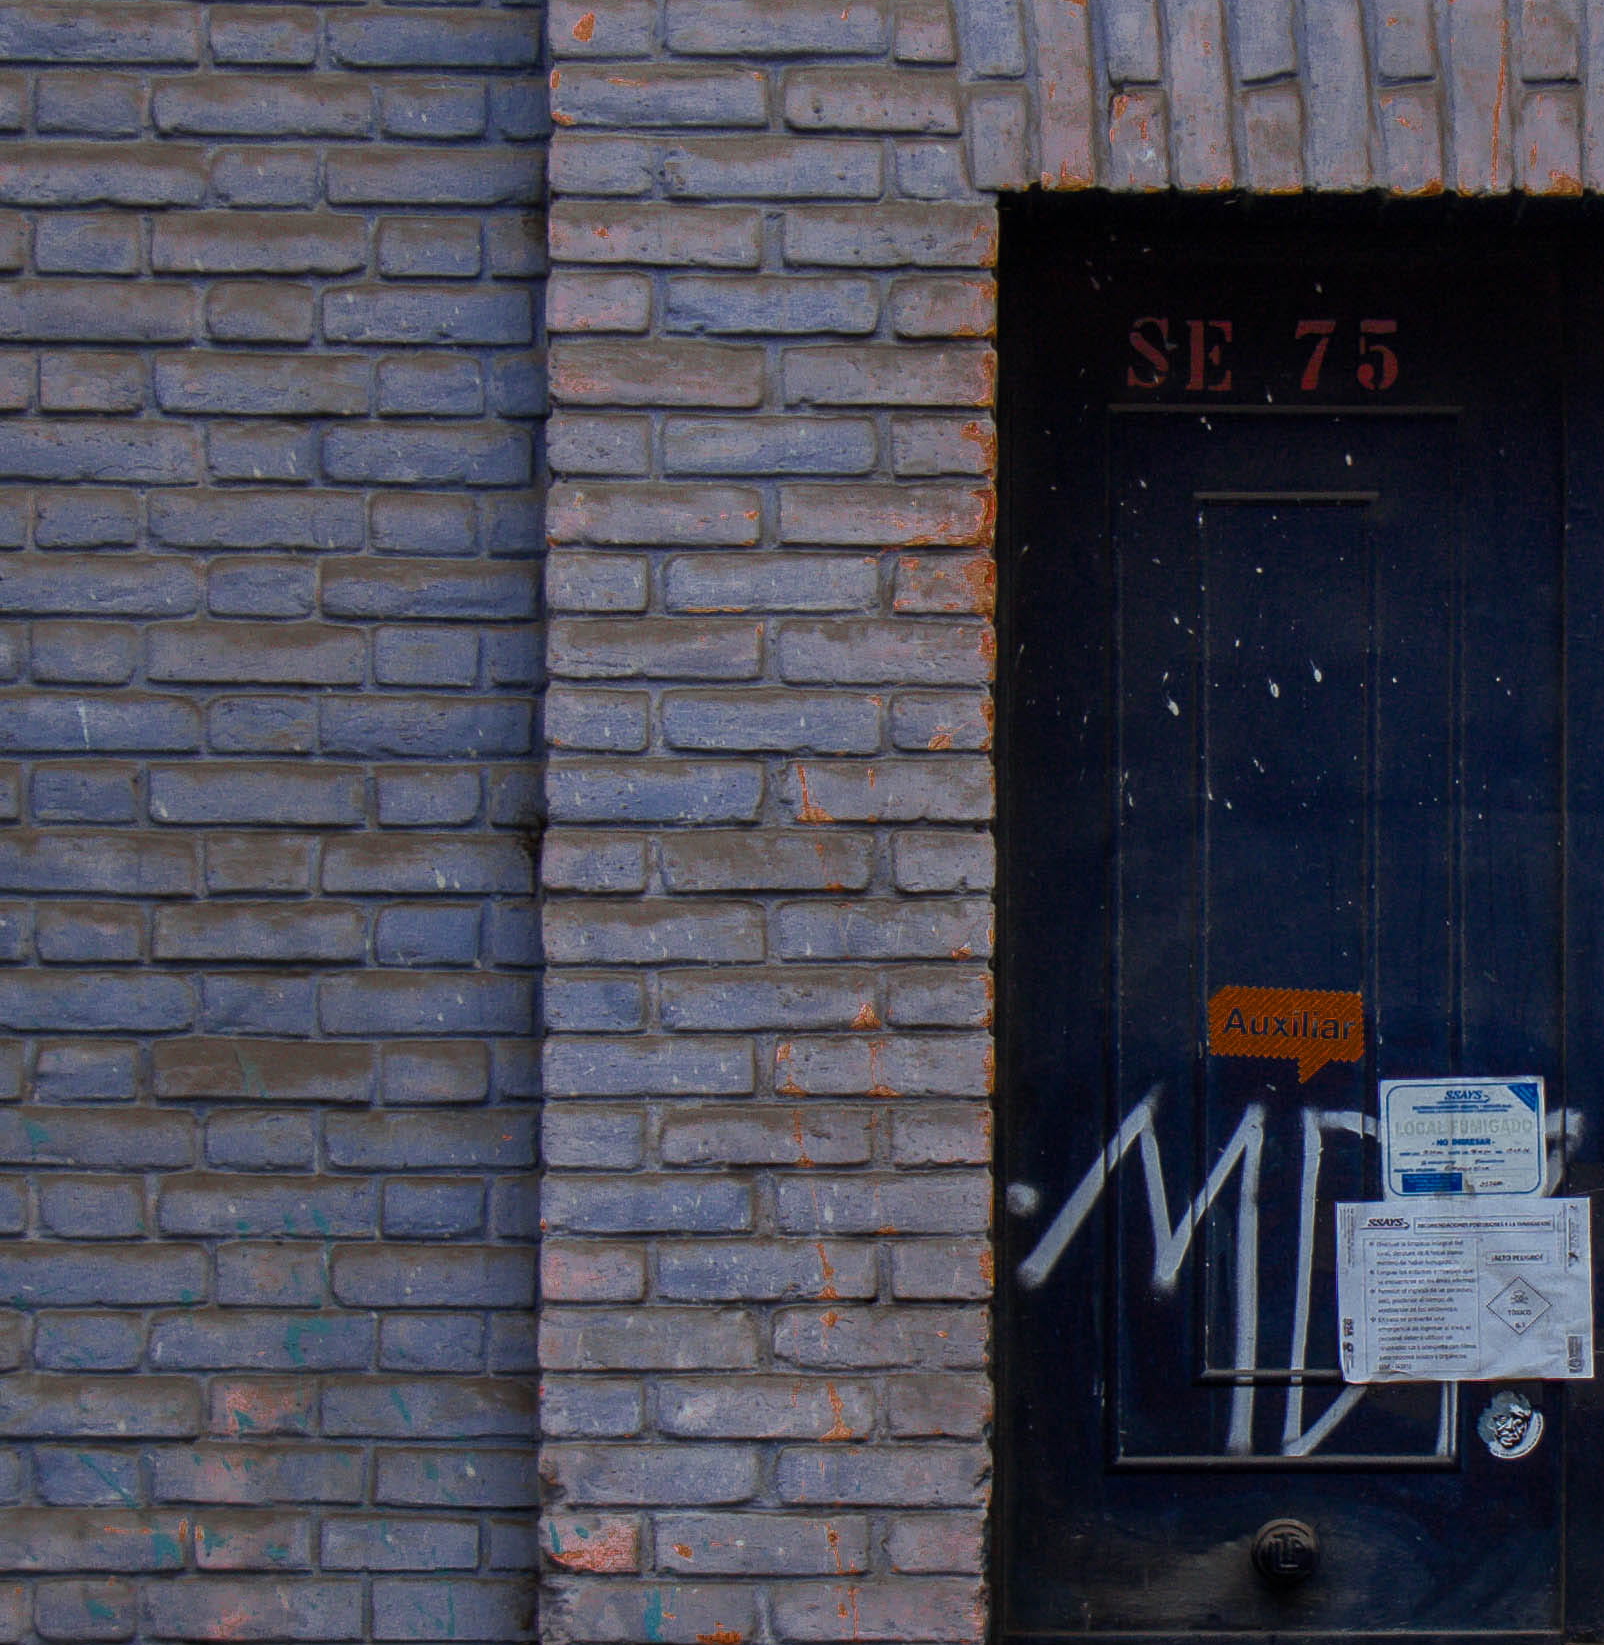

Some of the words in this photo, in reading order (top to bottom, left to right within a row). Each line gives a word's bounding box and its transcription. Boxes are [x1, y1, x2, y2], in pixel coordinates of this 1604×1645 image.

[1125, 316, 1234, 392] SE
[1293, 317, 1402, 392] 75
[1223, 1007, 1356, 1040] Auxiliar
[1444, 1090, 1484, 1101] SSAYS
[1395, 1121, 1445, 1138] LOCAL
[1451, 1118, 1534, 1136] FUMIGADO
[1367, 1218, 1405, 1227] SSAYS
